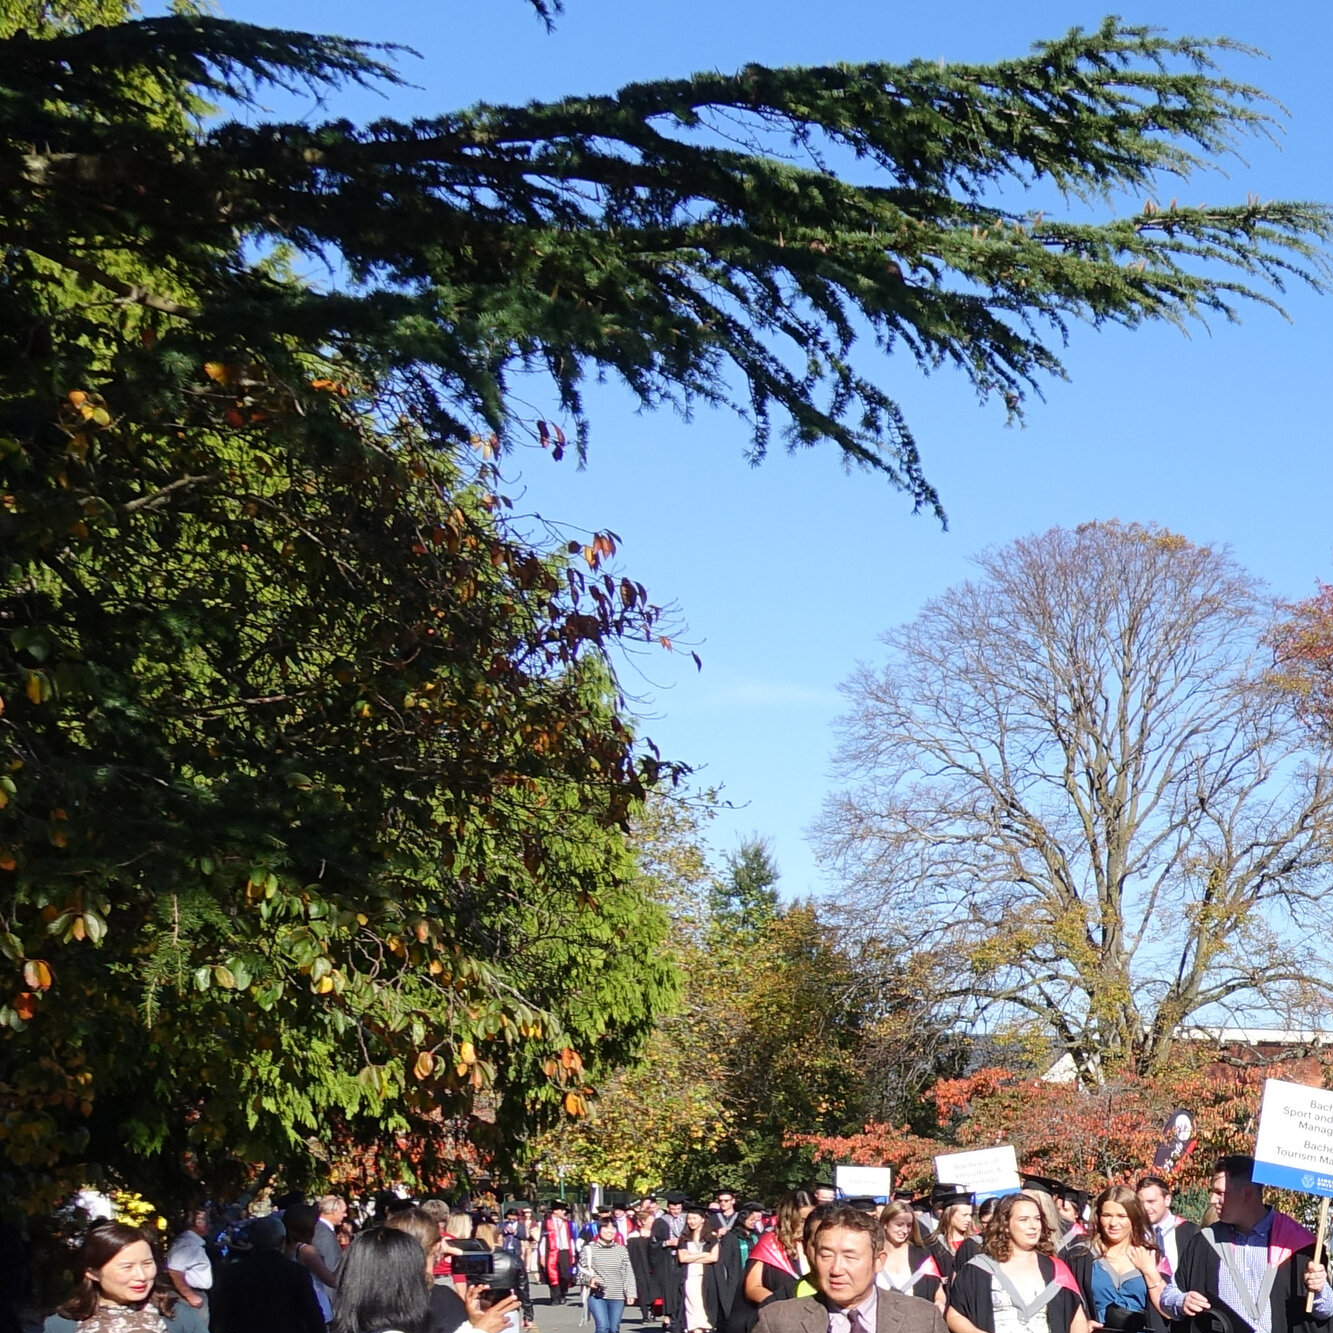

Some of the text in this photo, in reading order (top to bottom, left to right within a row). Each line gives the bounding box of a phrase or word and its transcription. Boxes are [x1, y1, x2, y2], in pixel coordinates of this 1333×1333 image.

[1283, 1106, 1312, 1119] Sport
[1314, 1114, 1333, 1124] and
[1276, 1146, 1317, 1162] Tourism
